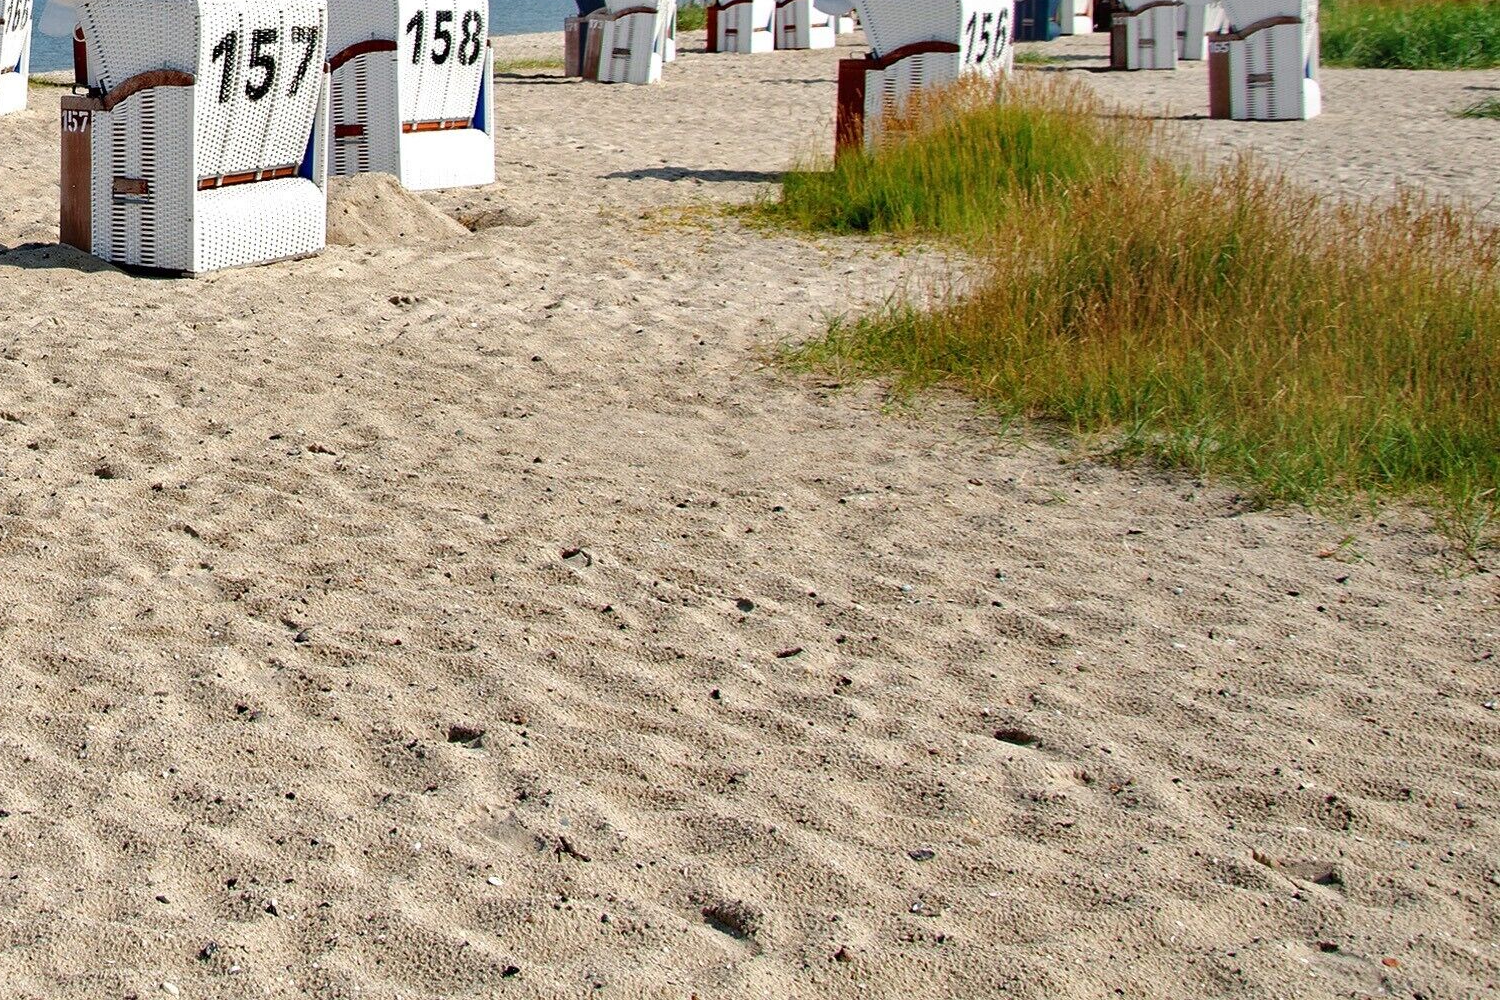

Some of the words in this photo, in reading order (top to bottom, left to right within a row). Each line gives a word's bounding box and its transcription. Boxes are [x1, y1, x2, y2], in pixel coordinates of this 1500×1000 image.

[406, 10, 483, 65] 158
[966, 8, 1008, 63] 156
[212, 26, 318, 103] 157
[62, 110, 89, 132] 157
